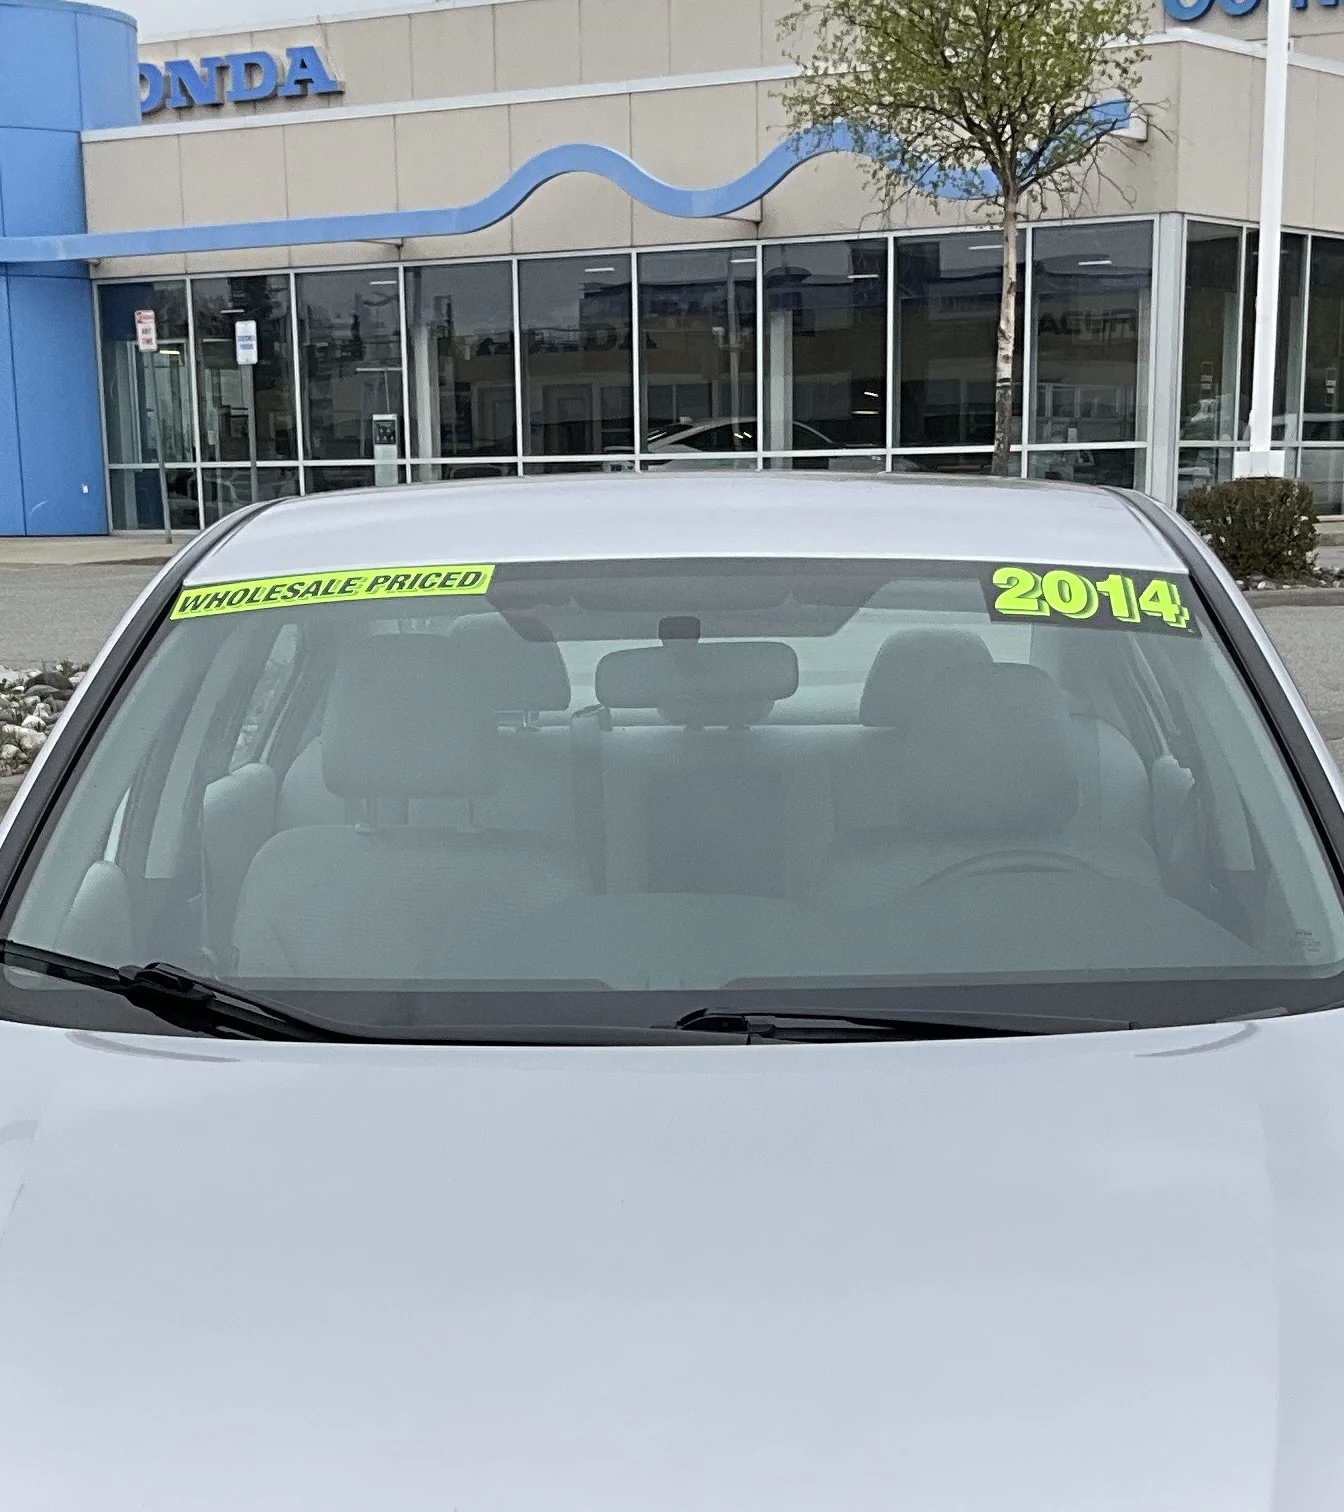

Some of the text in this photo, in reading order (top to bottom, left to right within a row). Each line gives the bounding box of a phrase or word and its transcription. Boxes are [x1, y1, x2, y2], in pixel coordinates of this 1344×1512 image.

[178, 570, 485, 614] WHOLESALE PRICED
[992, 567, 1190, 629] 2014
